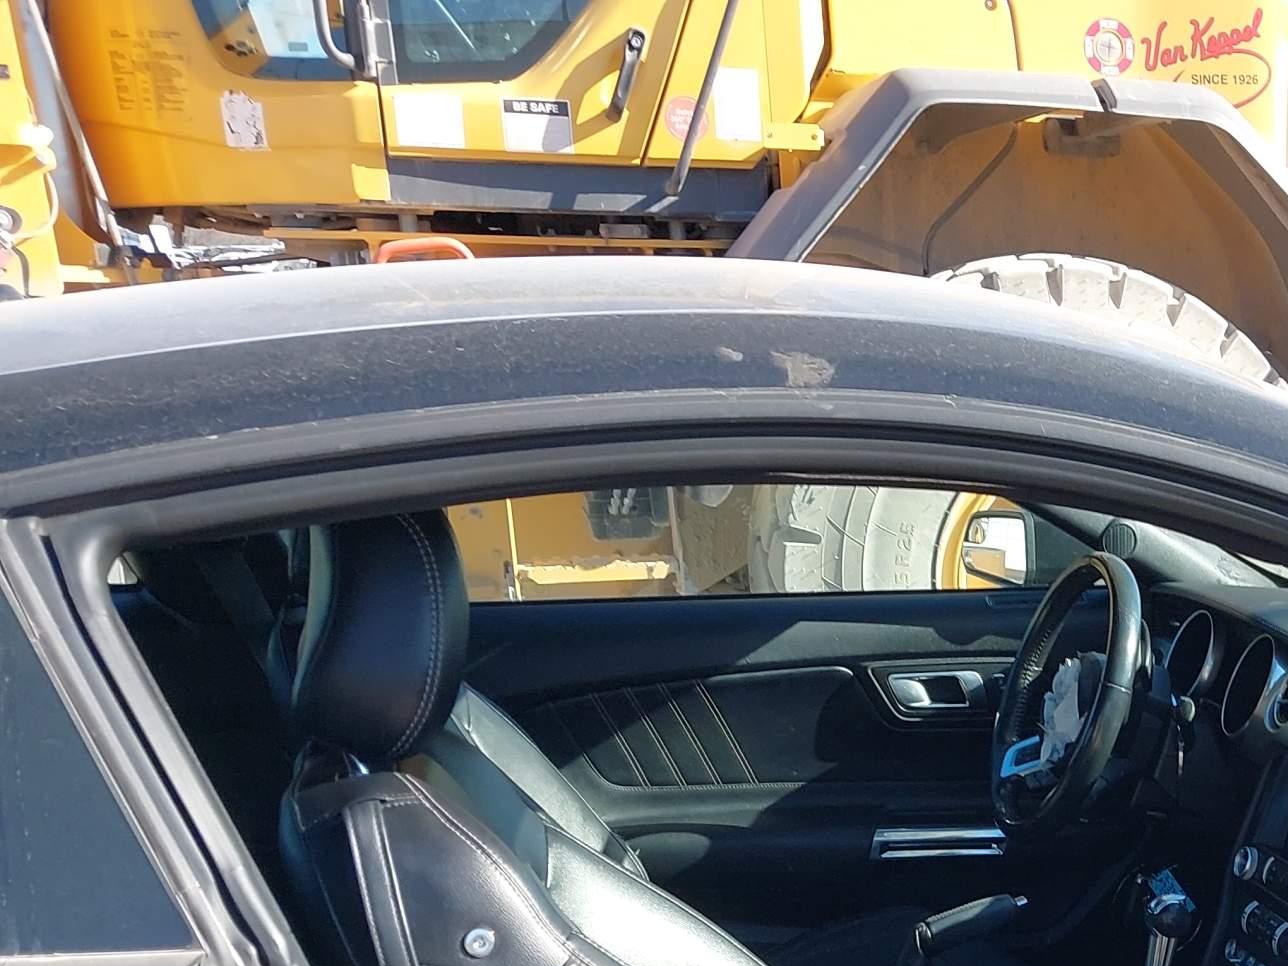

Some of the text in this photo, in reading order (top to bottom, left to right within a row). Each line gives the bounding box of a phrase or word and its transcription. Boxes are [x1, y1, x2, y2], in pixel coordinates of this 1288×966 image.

[1141, 20, 1188, 71] Van
[1191, 74, 1259, 85] SINCE 1926
[512, 101, 559, 114] BE SAFE
